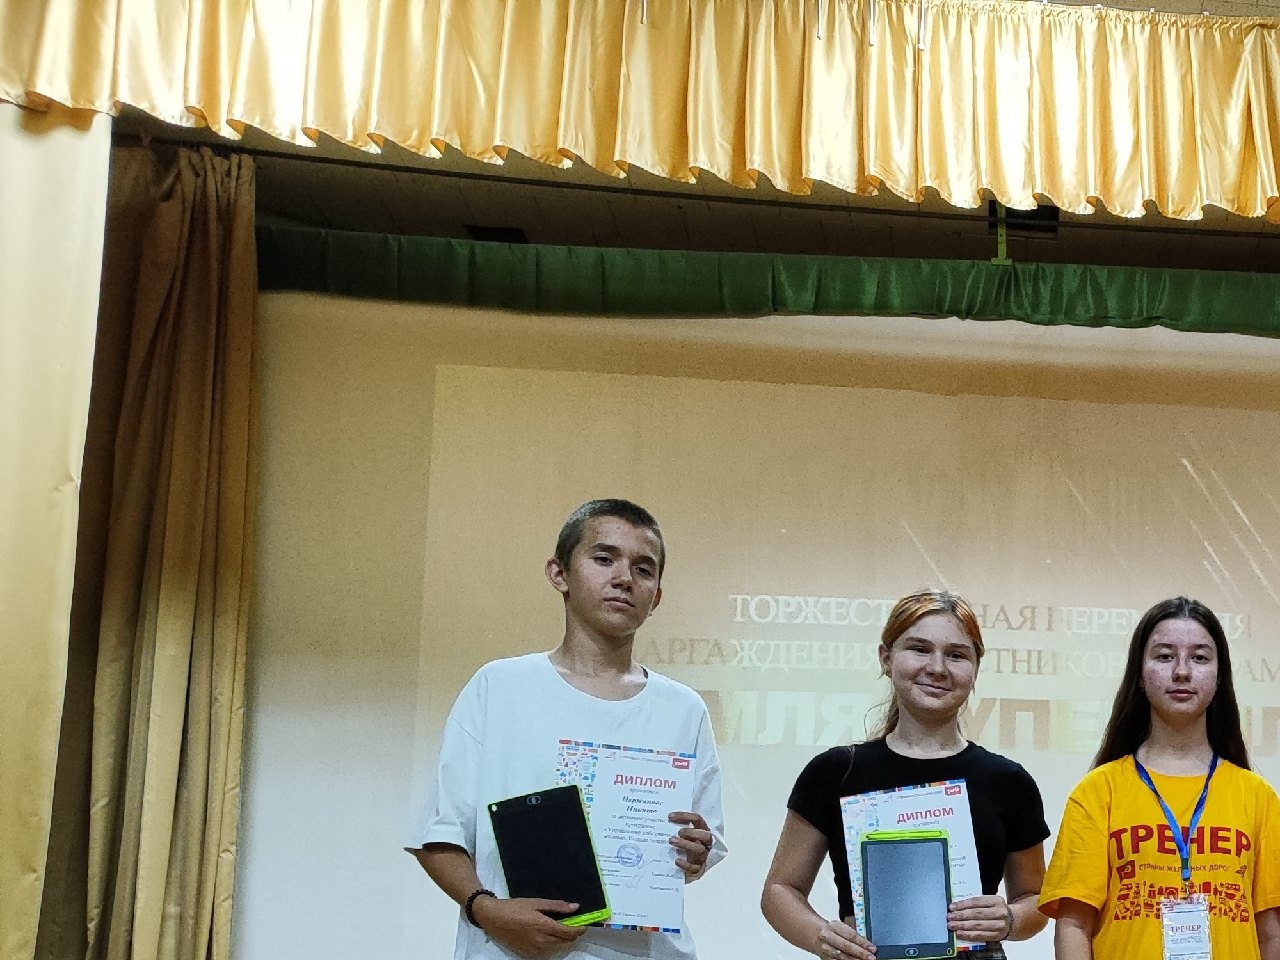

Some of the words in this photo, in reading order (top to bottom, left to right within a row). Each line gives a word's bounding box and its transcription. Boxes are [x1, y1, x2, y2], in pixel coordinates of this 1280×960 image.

[613, 774, 677, 790] ДИПЛОМ
[896, 807, 954, 825] ДИПЛОМ
[1109, 823, 1252, 861] ТРЕНЕР
[1138, 863, 1165, 872] СТРАНЫ
